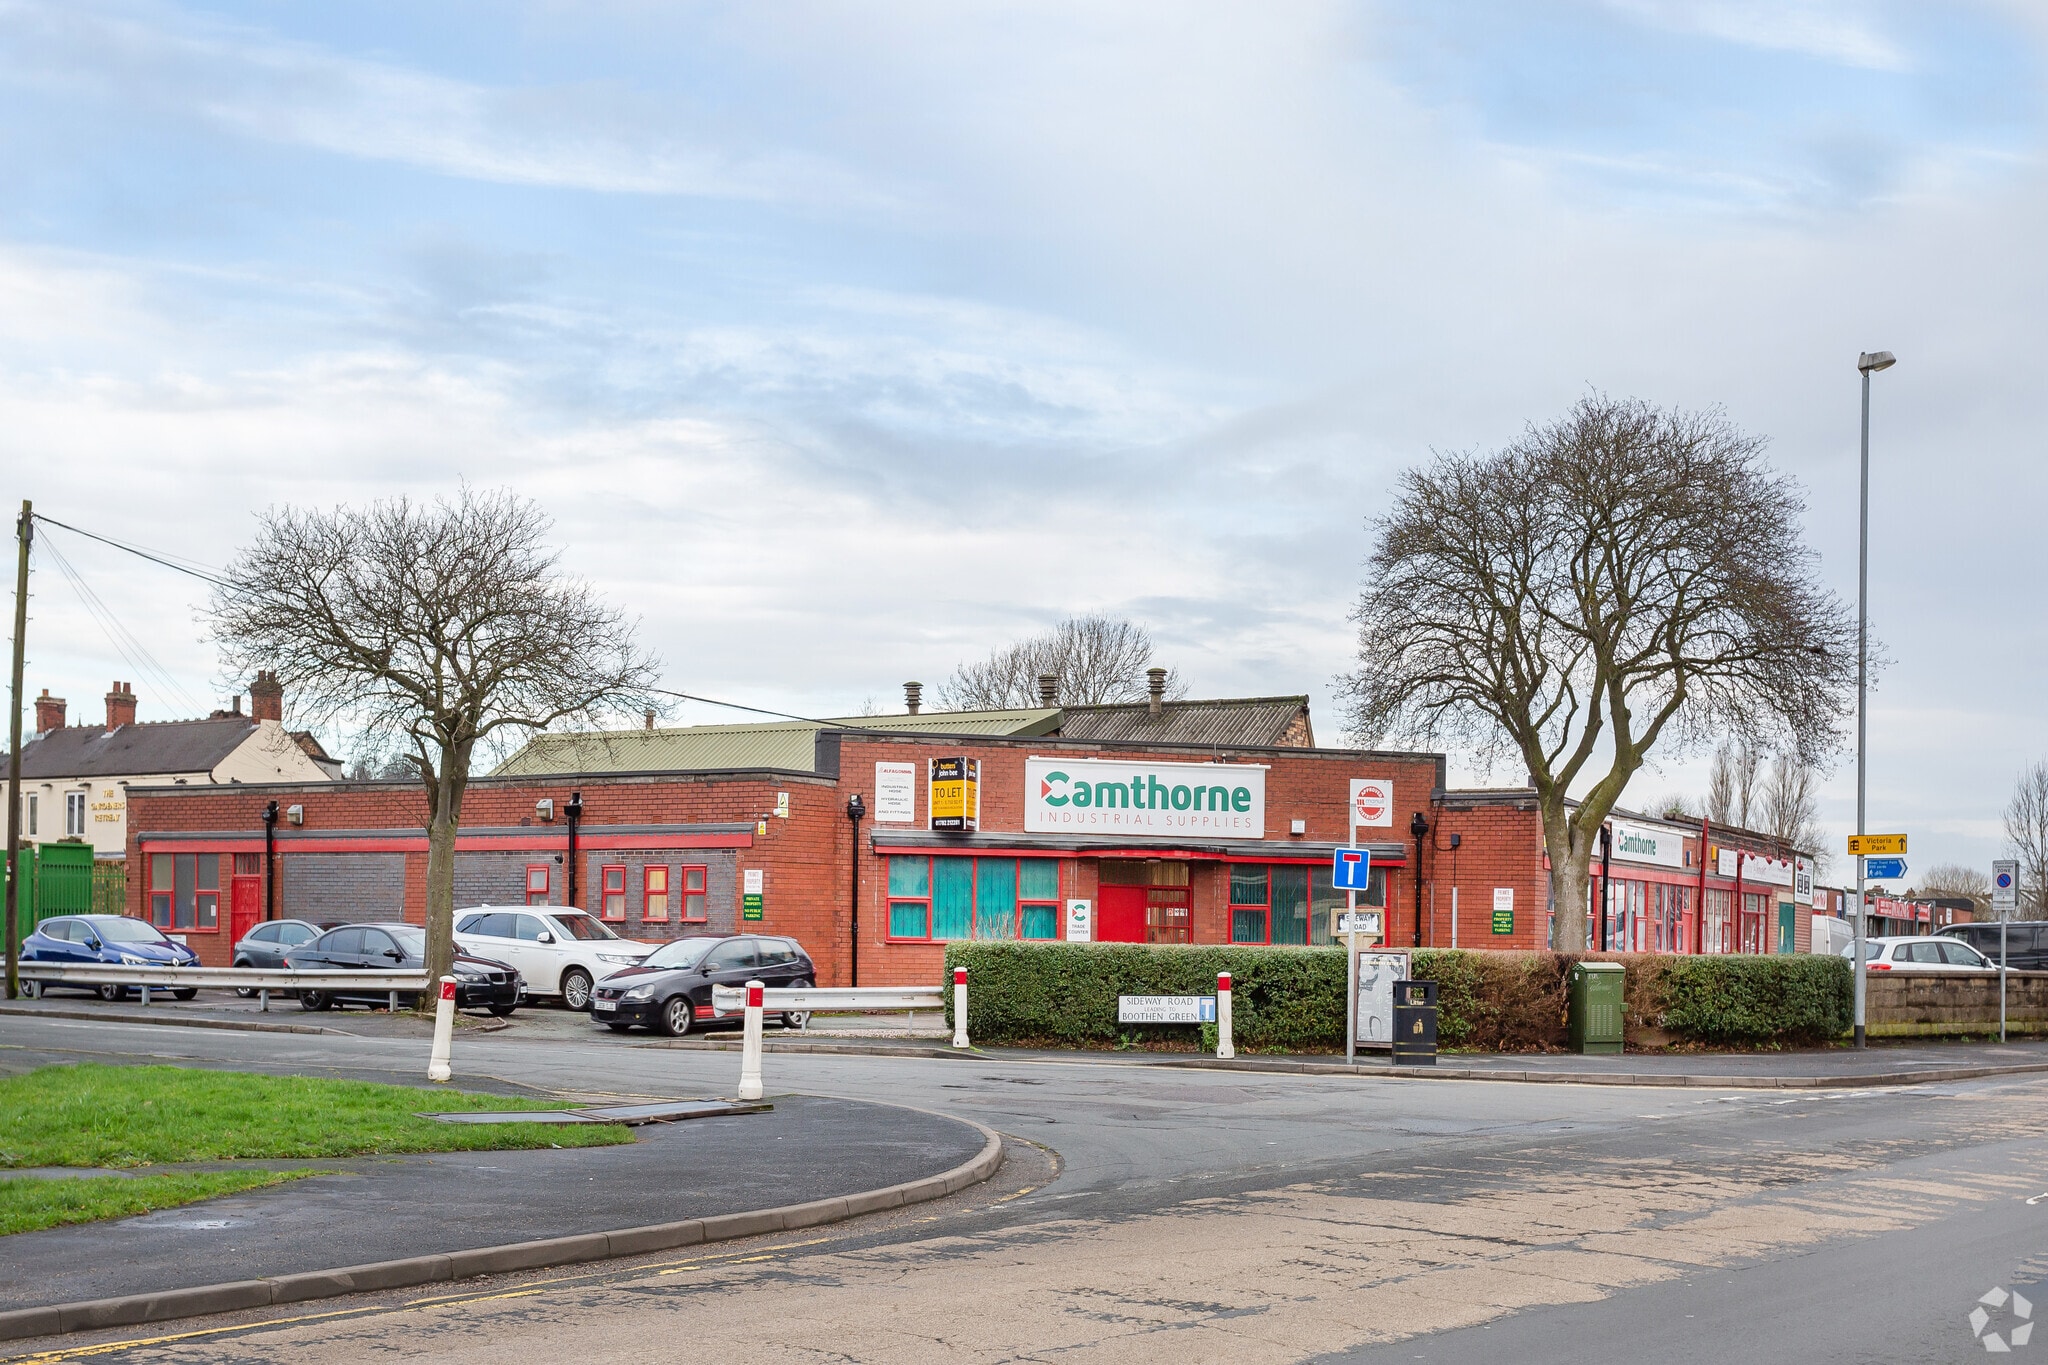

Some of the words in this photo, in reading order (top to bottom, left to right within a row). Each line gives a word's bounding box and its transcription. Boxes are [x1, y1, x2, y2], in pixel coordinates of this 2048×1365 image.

[103, 790, 114, 798] THE
[934, 788, 946, 798] TO
[947, 787, 962, 798] LET
[1041, 771, 1252, 812] Camthorne
[1040, 812, 1153, 826] INDUSTRIAL
[1166, 815, 1251, 828] SUPPLIES
[1618, 829, 1656, 856] Camthorne
[1346, 914, 1373, 922] SEWAY
[1126, 997, 1162, 1005] SIDEWAY
[1167, 997, 1194, 1006] ROAD
[1122, 1013, 1163, 1021] BOOTHEN
[1168, 1013, 1197, 1021] GREEN
